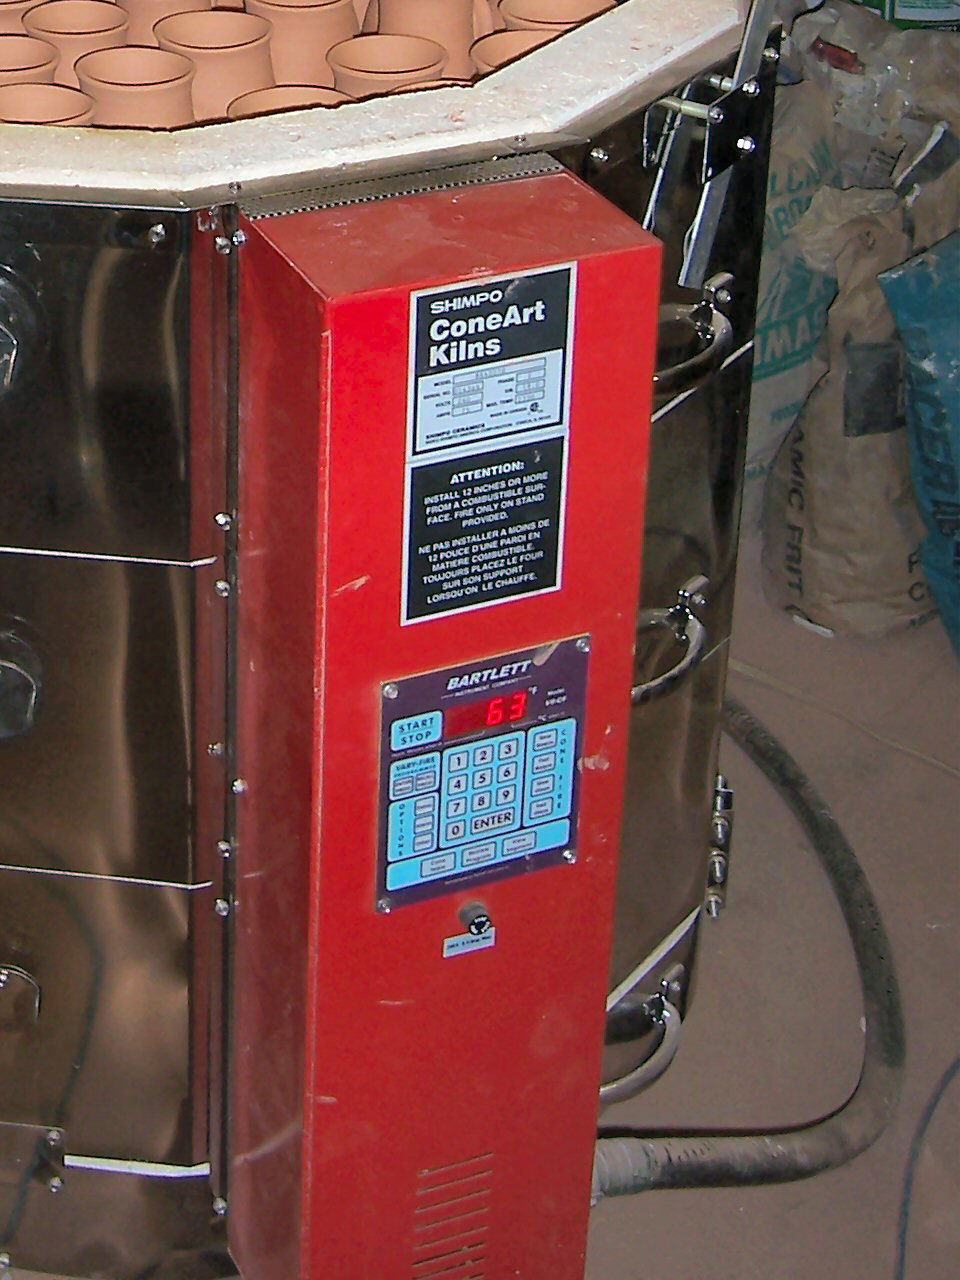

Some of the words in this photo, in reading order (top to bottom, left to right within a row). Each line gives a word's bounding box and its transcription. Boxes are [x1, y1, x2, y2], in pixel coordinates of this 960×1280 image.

[430, 290, 503, 314] SHIMPO
[429, 301, 546, 341] ConeArt
[429, 337, 501, 367] Kilns
[449, 460, 525, 485] ATTENTION:
[424, 491, 460, 505] INSTALL
[462, 488, 472, 497] 12
[473, 480, 506, 494] INCHES
[507, 478, 521, 487] OR
[523, 471, 549, 482] MORE
[426, 503, 452, 515] FROM
[453, 501, 460, 509] A
[461, 487, 523, 507] COMBUSTIBLE
[454, 508, 474, 519] FIRE
[475, 502, 499, 514] ONLY
[500, 498, 514, 509] ON
[515, 493, 545, 506] STAND
[462, 511, 509, 528] PROVIDED.
[418, 545, 431, 555] NE
[432, 540, 451, 552] PAS
[452, 530, 499, 547] INSTALLER
[508, 522, 536, 535] MOINS
[537, 519, 550, 528] DE
[428, 554, 438, 562] 12
[440, 546, 470, 560] POUCE
[500, 534, 527, 547] PAROI
[528, 531, 541, 540] EN
[422, 567, 469, 584] TOUJOURS
[471, 559, 505, 573] PLACEZ
[506, 556, 518, 565] LE
[519, 550, 544, 563] FOUR
[442, 579, 460, 590] SUR
[462, 575, 481, 586] SON
[482, 565, 523, 581] SUPPORT
[482, 581, 494, 592] LE
[446, 659, 532, 691] BARTLETT
[485, 691, 528, 727] 63
[399, 717, 435, 733] START
[400, 730, 432, 745] STOP
[480, 750, 488, 761] 2
[504, 744, 512, 755] 3
[456, 757, 461, 767] 1
[479, 773, 486, 784] 5
[503, 767, 511, 778] 6
[453, 779, 461, 789] 4
[478, 796, 485, 807] 8
[503, 790, 510, 800] 9
[453, 803, 460, 813] 7
[474, 812, 512, 830] ENTER
[452, 825, 460, 836] 0
